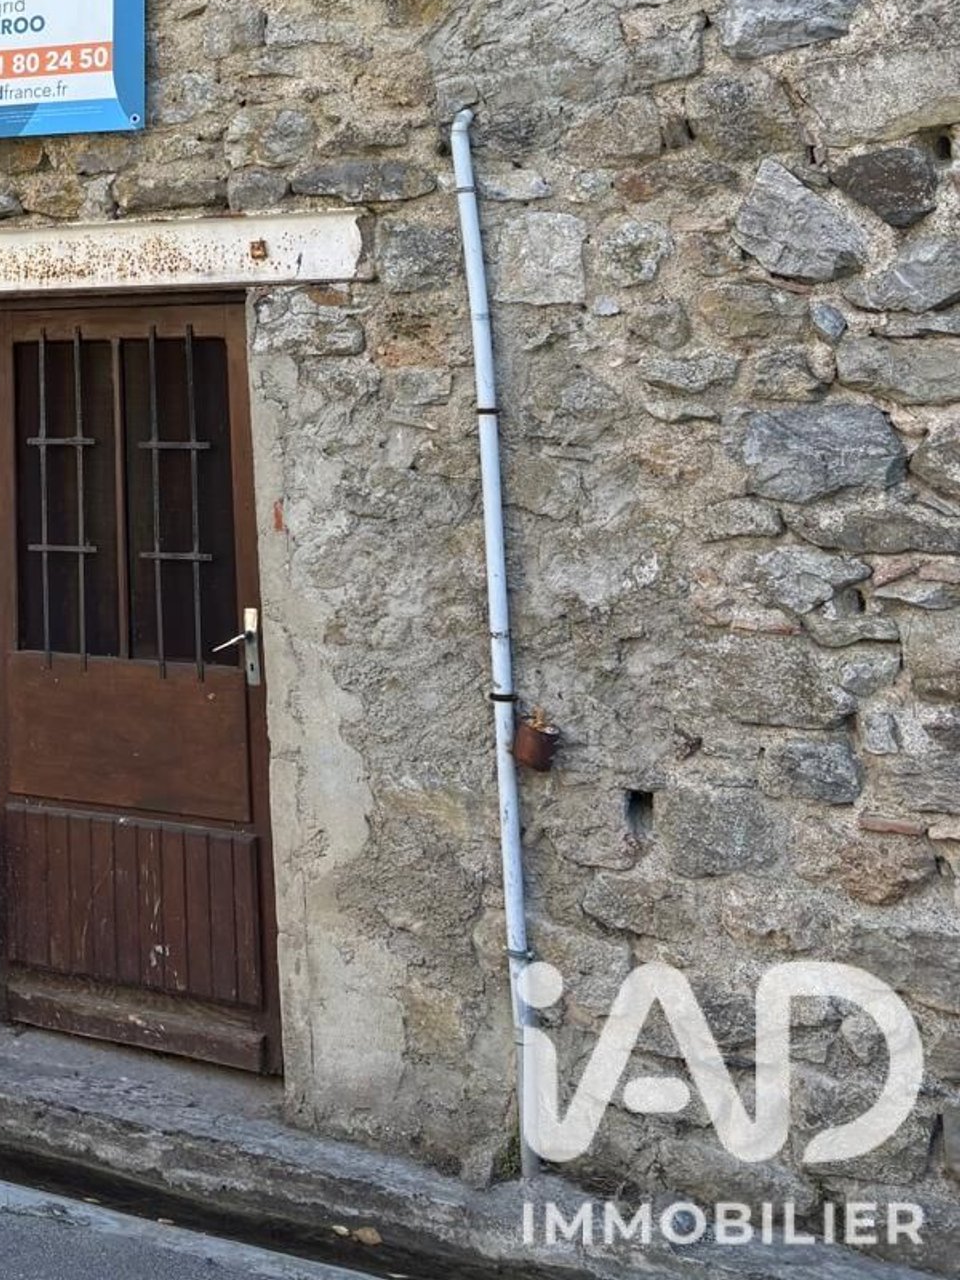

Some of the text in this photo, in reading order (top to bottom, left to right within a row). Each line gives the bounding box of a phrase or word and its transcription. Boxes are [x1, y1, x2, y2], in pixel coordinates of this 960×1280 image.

[13, 54, 39, 73] 80
[45, 51, 74, 70] 24
[79, 48, 108, 67] 50
